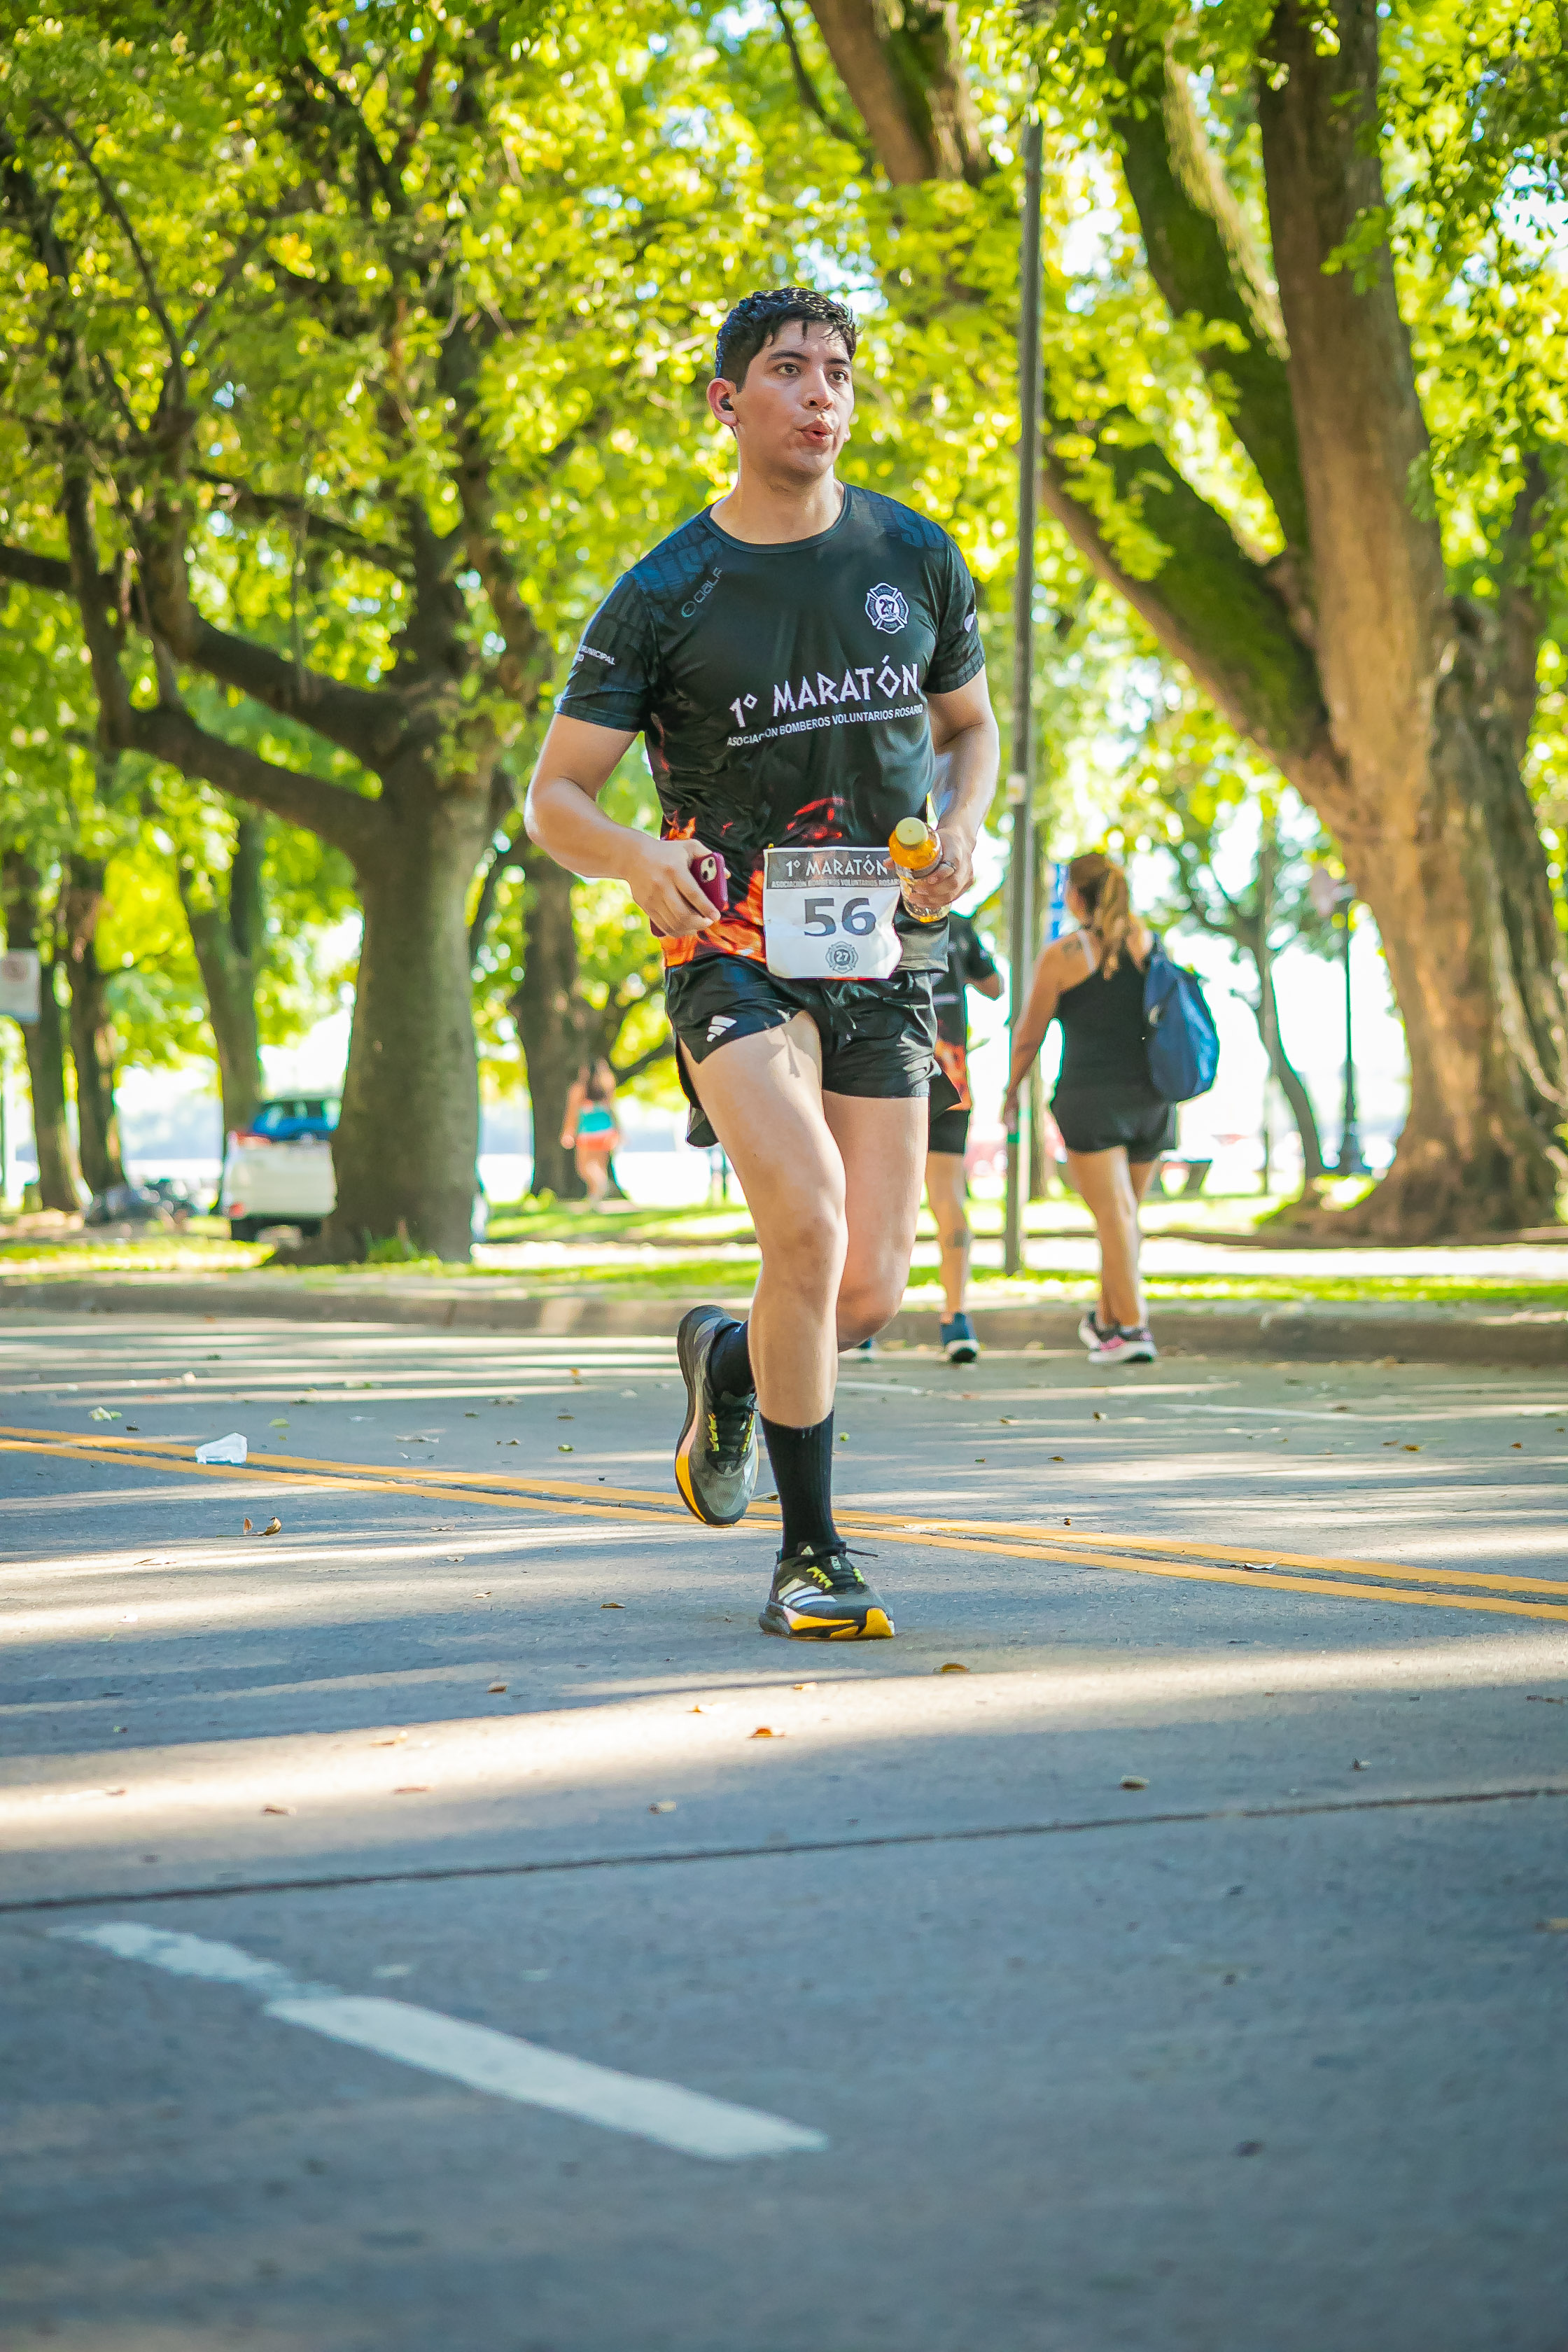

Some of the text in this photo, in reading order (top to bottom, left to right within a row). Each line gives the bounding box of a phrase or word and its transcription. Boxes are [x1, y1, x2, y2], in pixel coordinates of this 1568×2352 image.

[772, 654, 919, 717] MARATÓN
[779, 716, 831, 735] BOMBEROS
[832, 709, 894, 724] VOLUNTARIOS
[806, 855, 888, 876] MARATÓN
[804, 897, 876, 937] 56
[836, 951, 849, 963] 27
